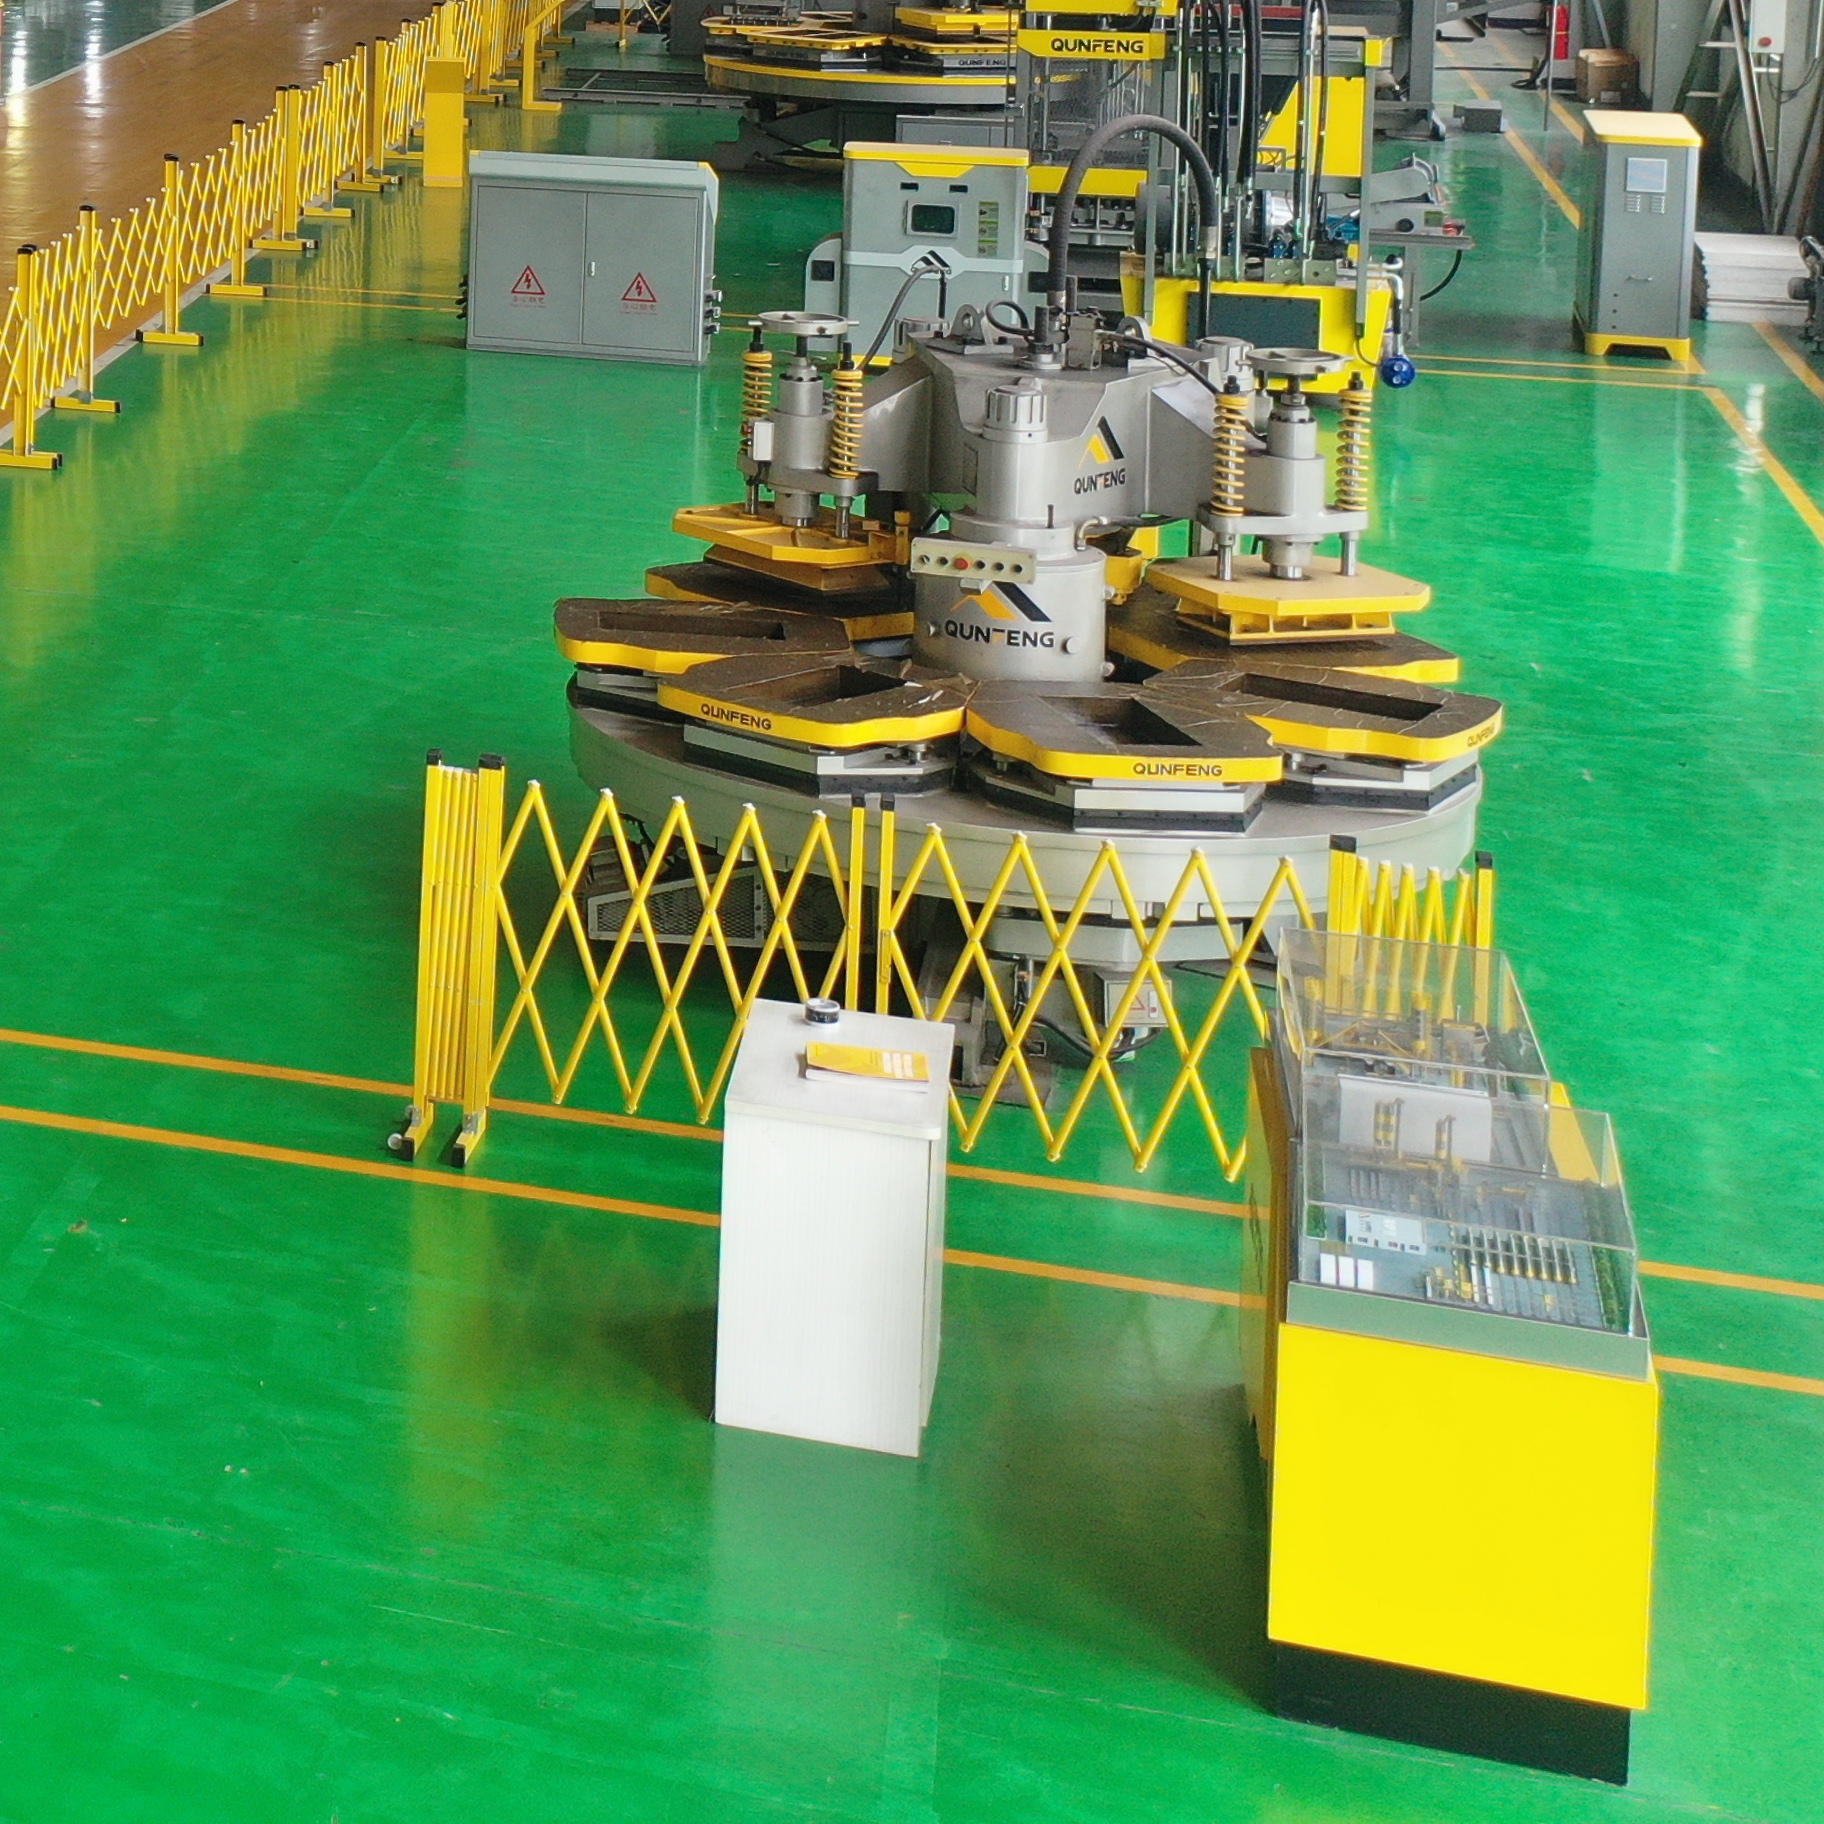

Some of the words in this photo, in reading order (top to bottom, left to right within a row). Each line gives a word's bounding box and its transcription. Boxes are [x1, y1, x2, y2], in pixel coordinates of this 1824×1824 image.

[1051, 38, 1144, 54] QUNFENG
[1074, 468, 1126, 495] QUNFENG
[945, 619, 1054, 648] QUNFENG
[701, 703, 772, 730] QUNFENG
[1133, 762, 1223, 777] QUNFENG
